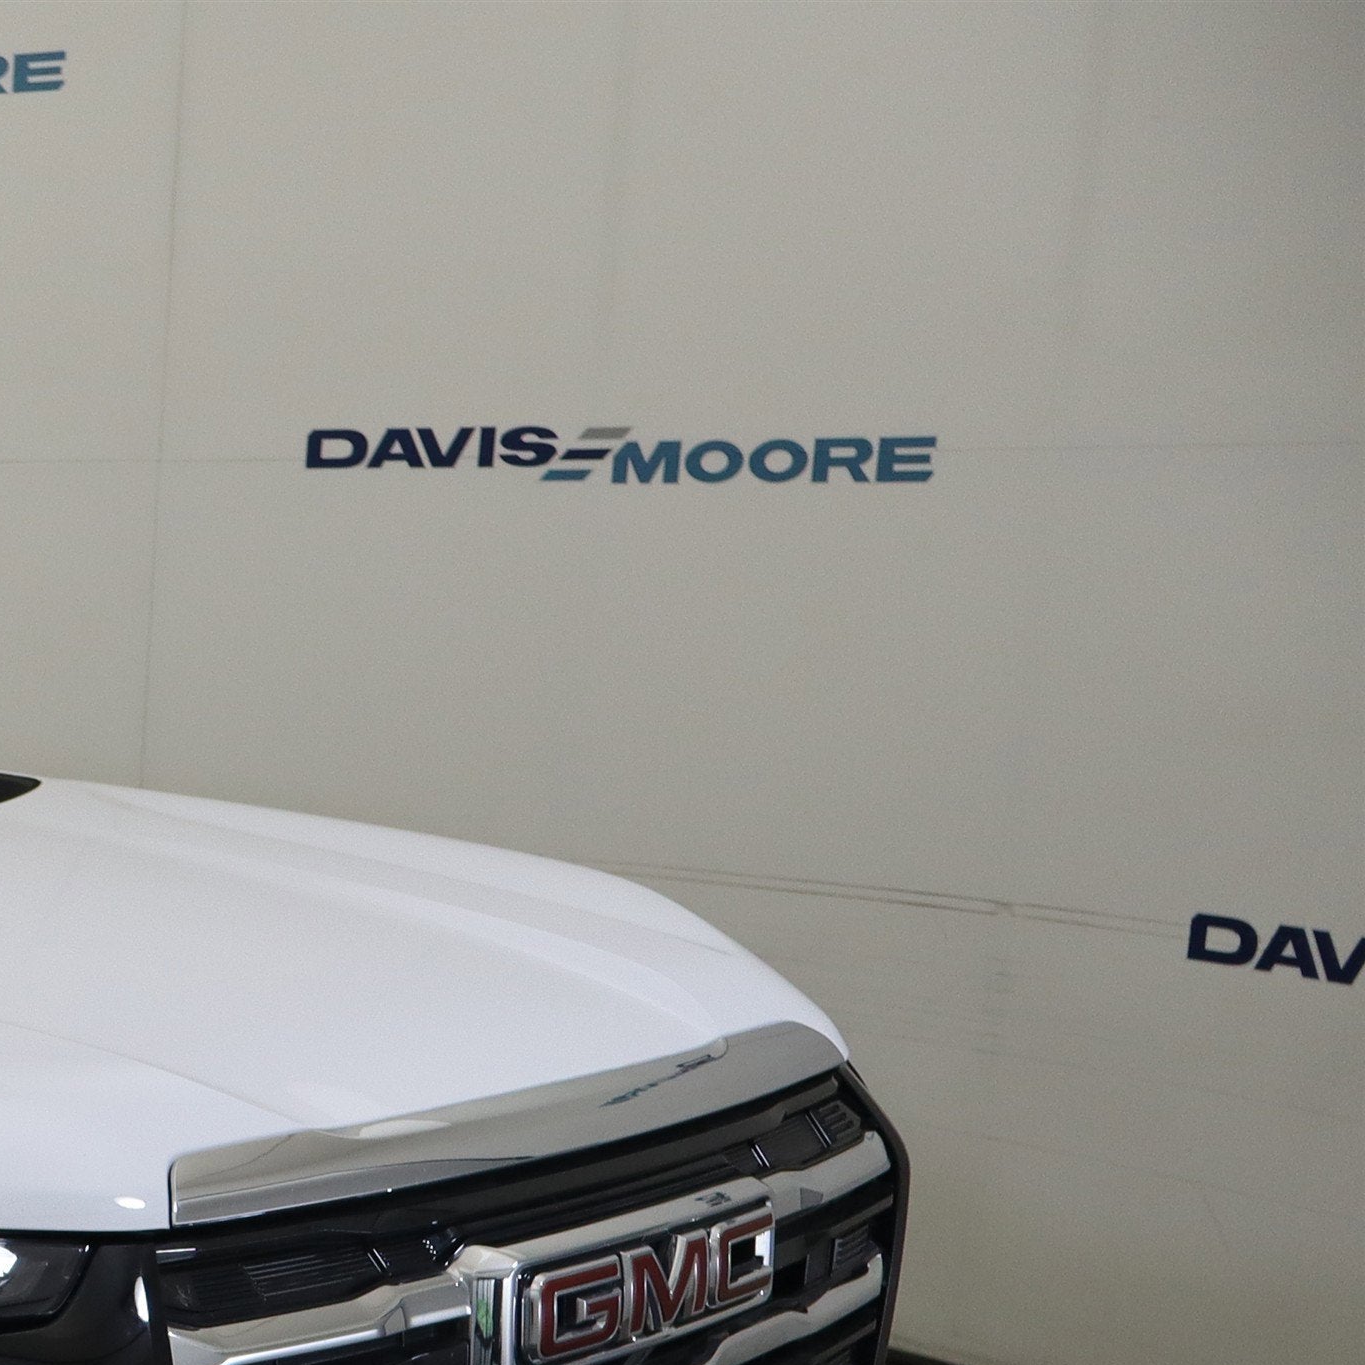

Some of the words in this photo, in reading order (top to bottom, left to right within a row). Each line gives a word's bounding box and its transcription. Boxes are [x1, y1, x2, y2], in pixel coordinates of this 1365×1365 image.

[305, 426, 559, 468] DAVIS
[611, 436, 937, 483] MOORE
[522, 1207, 774, 1364] GMC
